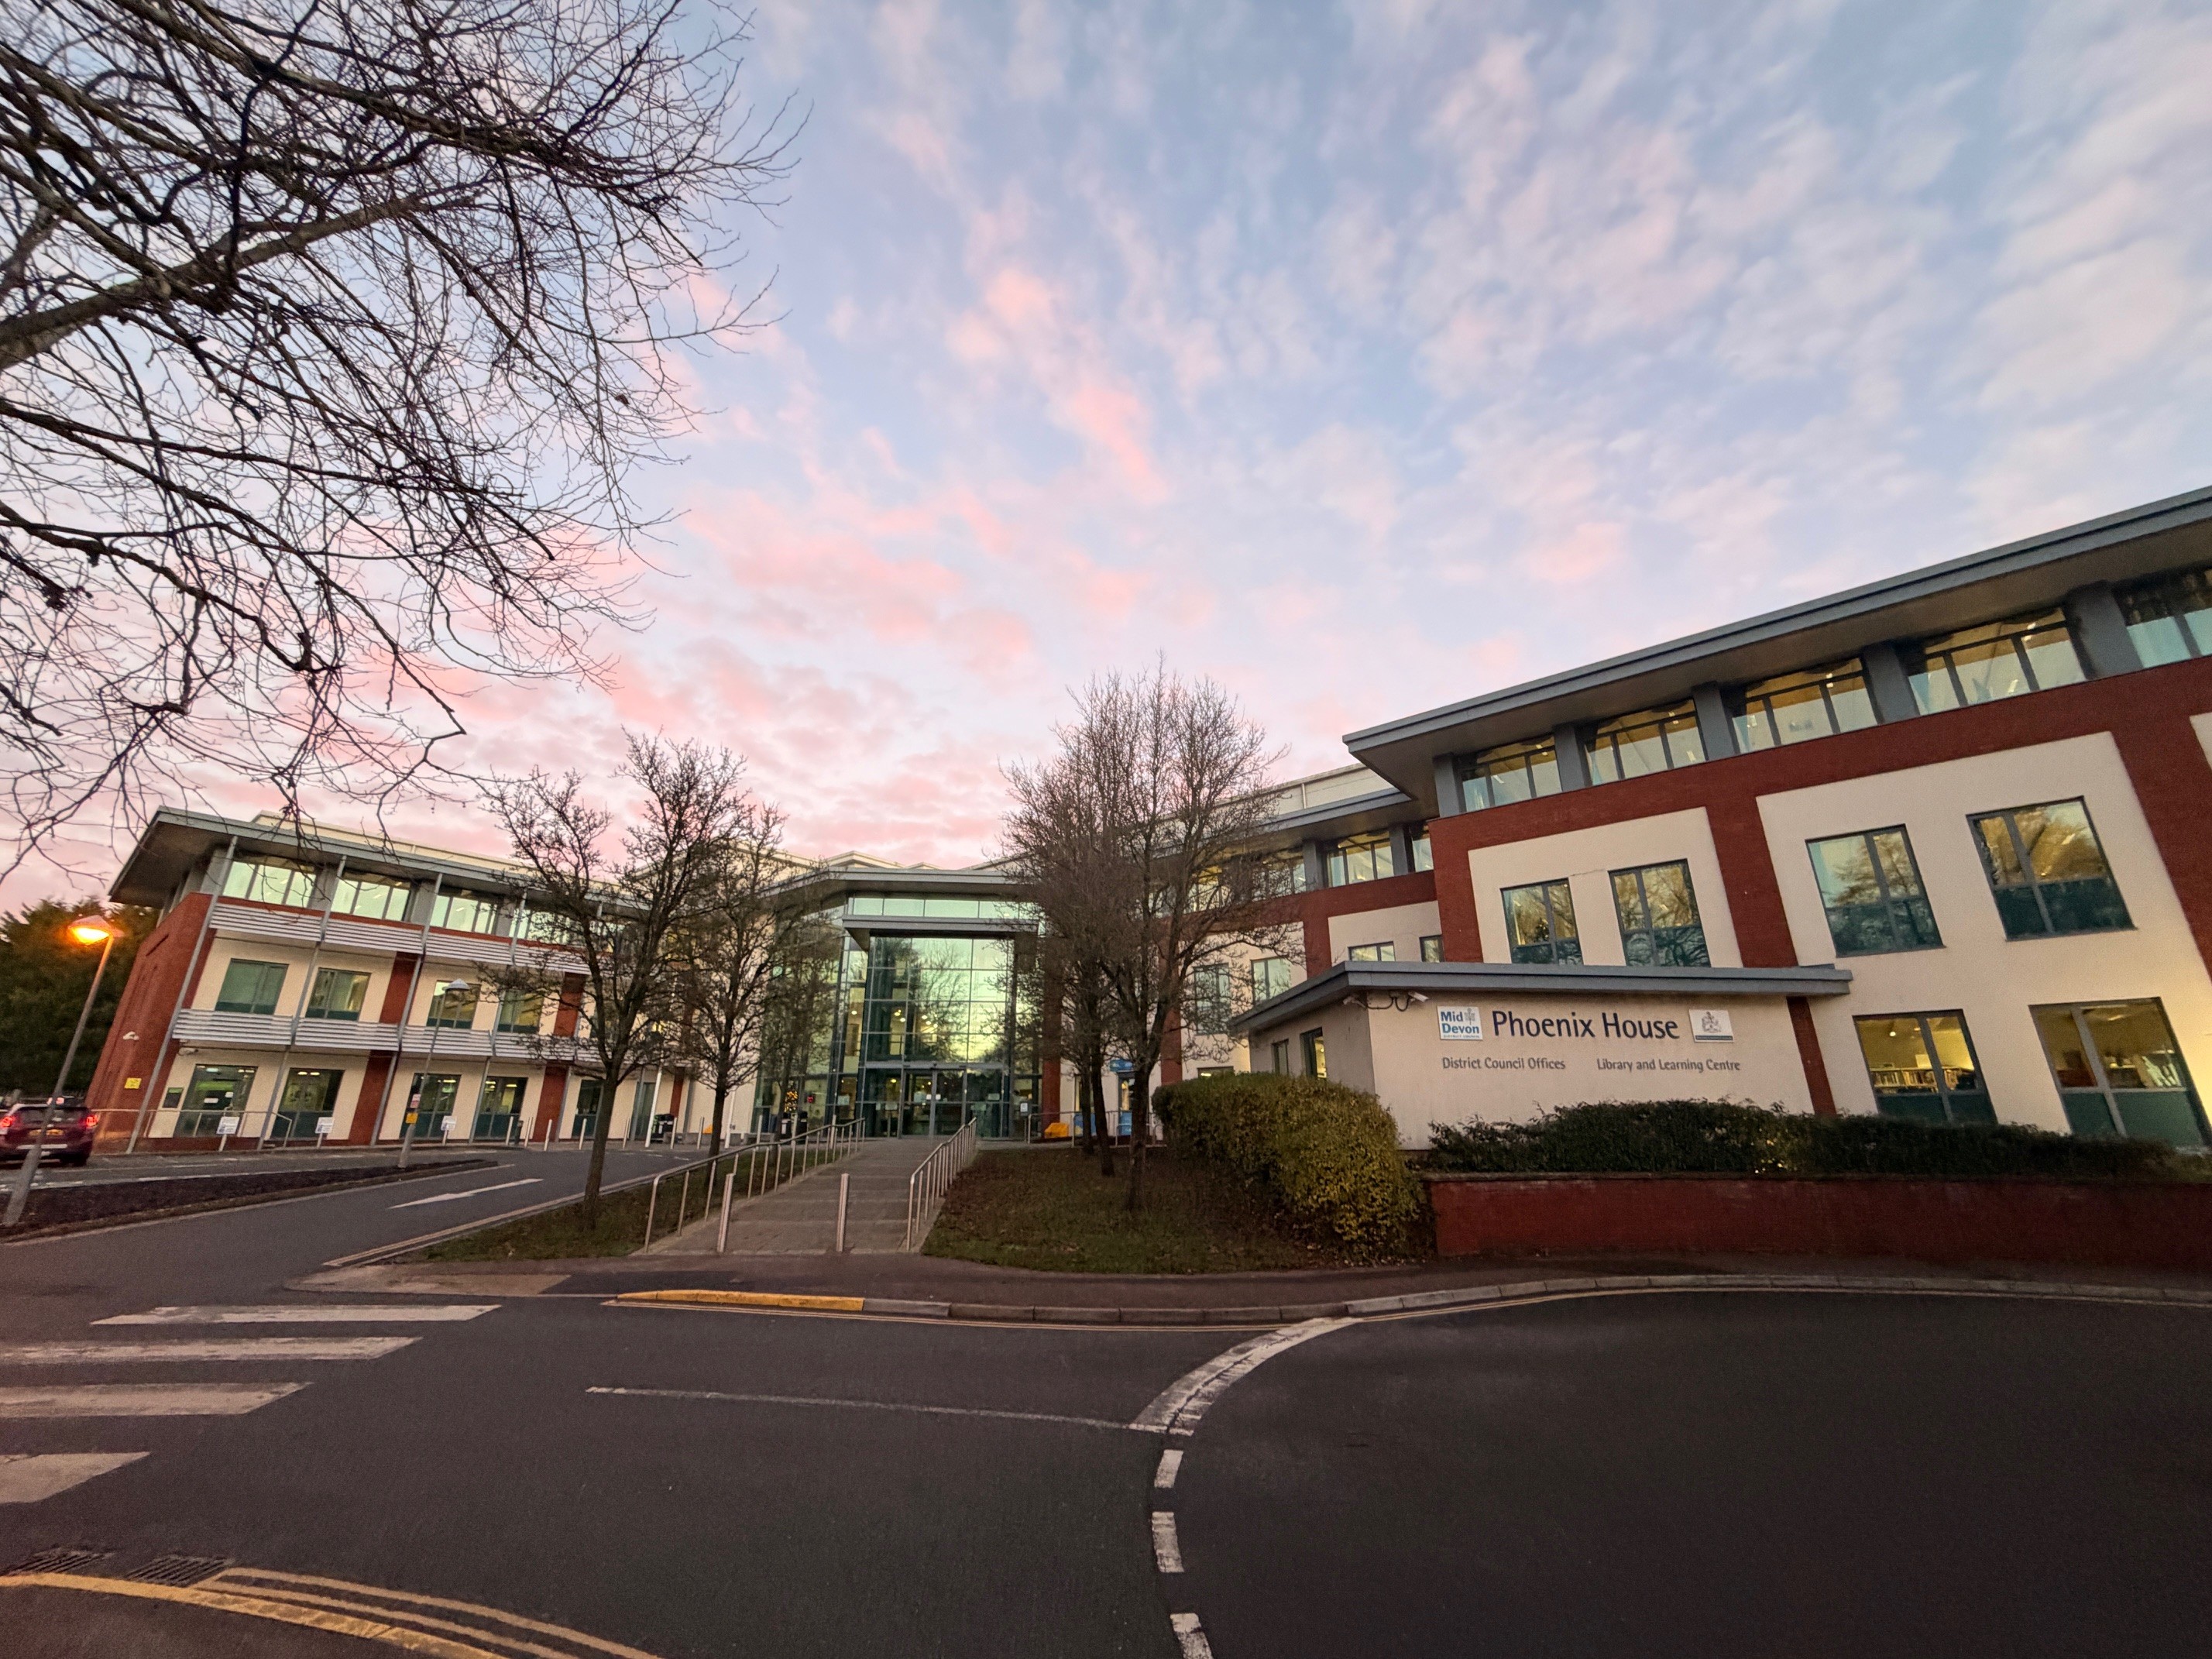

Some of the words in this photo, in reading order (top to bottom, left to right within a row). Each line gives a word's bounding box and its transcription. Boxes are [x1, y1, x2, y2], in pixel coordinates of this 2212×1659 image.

[1441, 1012, 1463, 1022] Mid
[1441, 1023, 1479, 1034] Devon
[1492, 1011, 1595, 1037] Phoenix
[1602, 1012, 1680, 1039] House
[1442, 1057, 1481, 1069] District
[1485, 1057, 1524, 1069] Council
[1527, 1057, 1566, 1070] Offices
[1597, 1058, 1633, 1073] Library
[1636, 1059, 1656, 1070] and
[1658, 1059, 1704, 1073] Learning
[1705, 1059, 1741, 1071] Centre
